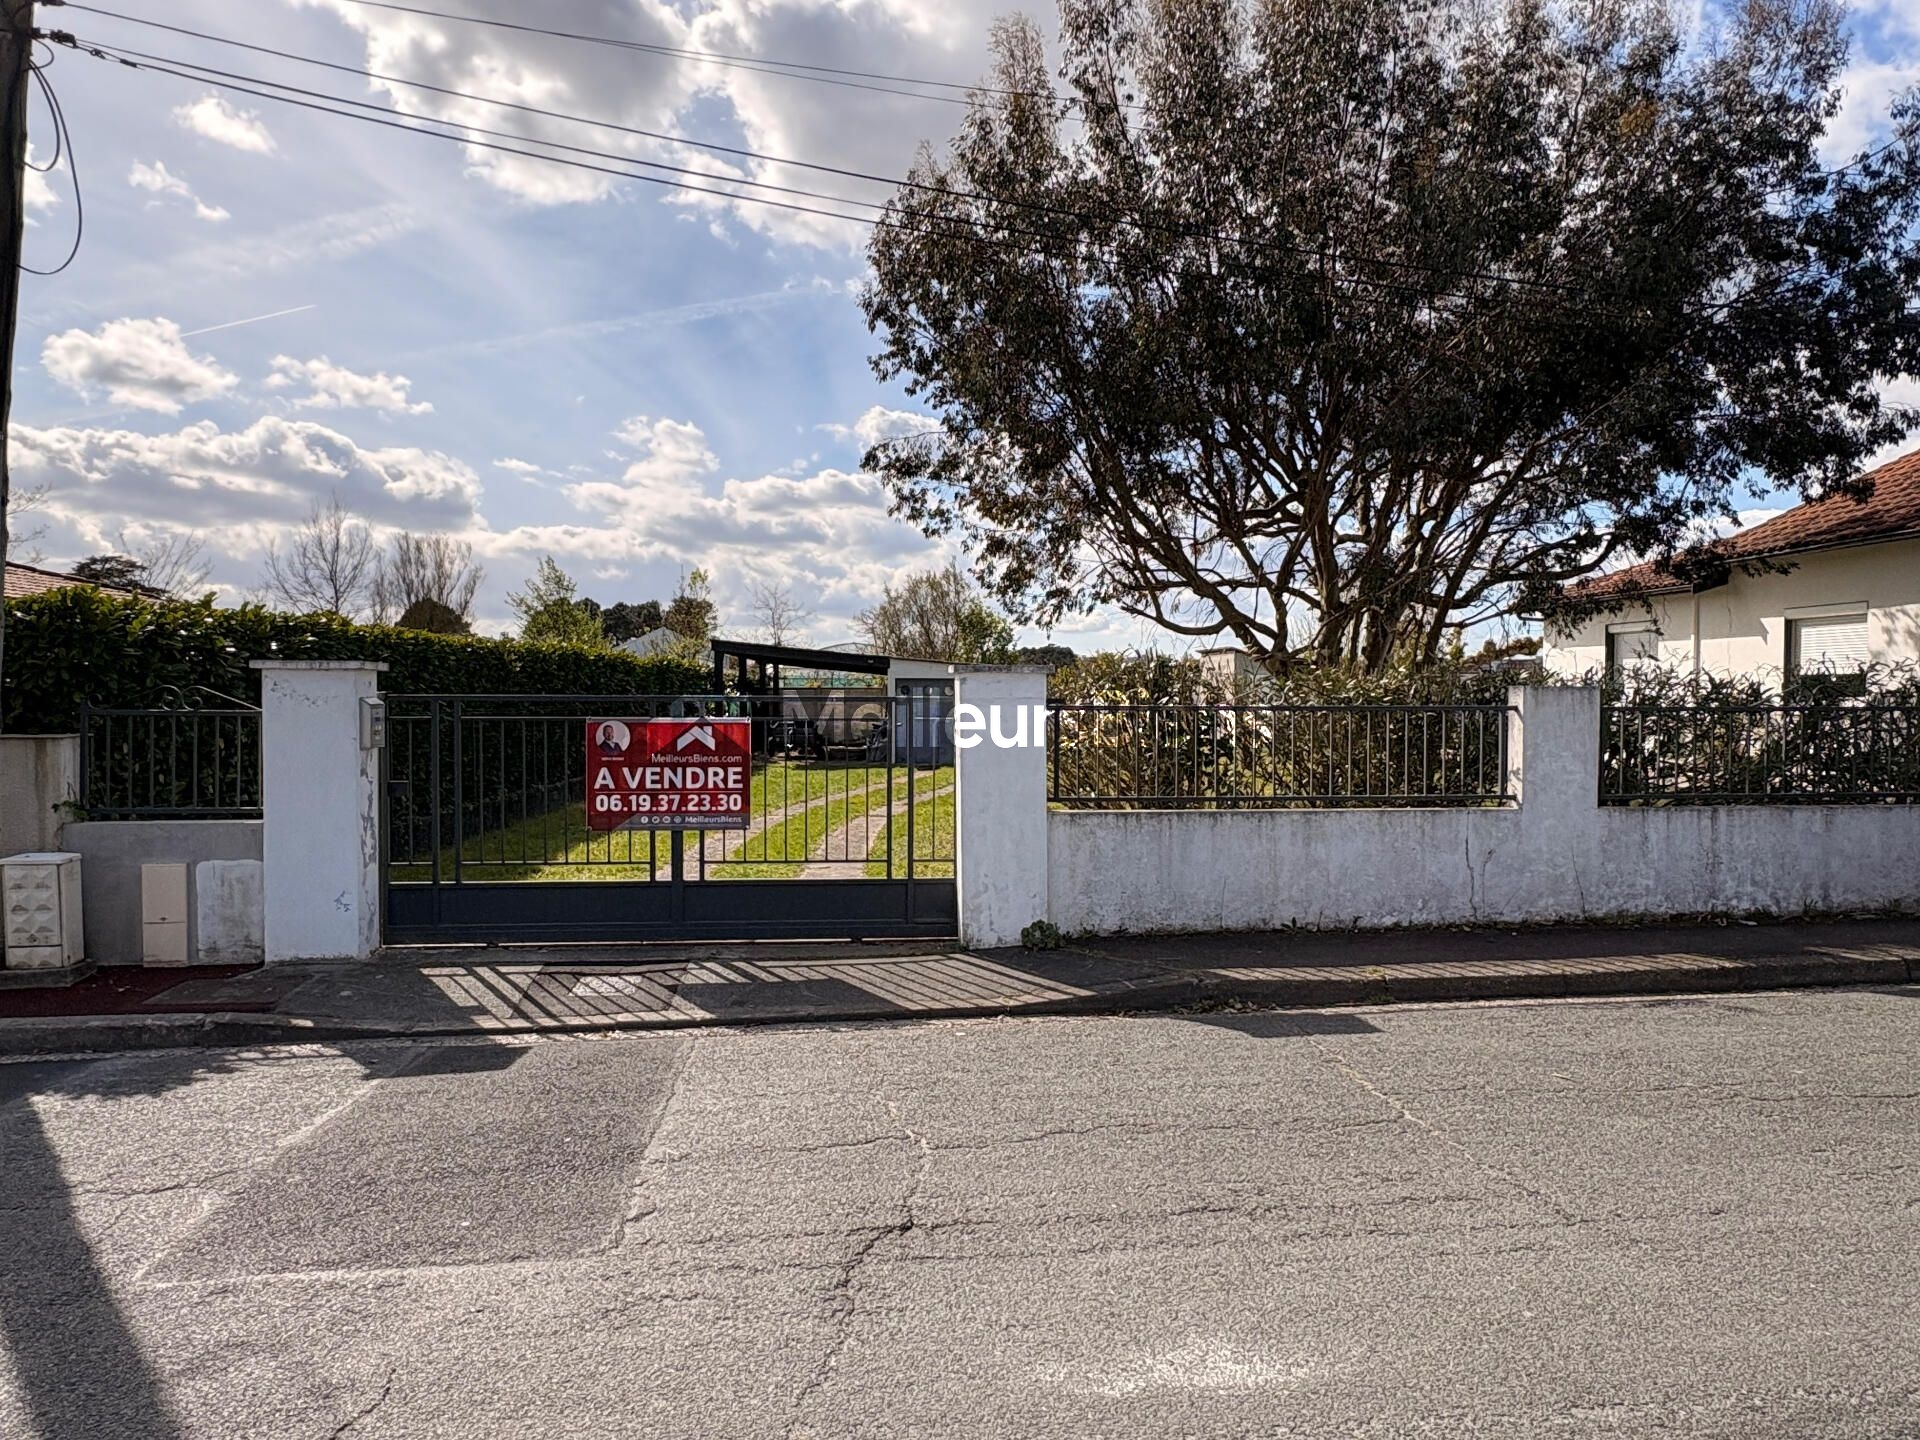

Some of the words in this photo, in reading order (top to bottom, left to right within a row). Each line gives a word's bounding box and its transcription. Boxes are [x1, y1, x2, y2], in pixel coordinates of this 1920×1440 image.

[652, 754, 742, 763] MeilleursBiens.com
[594, 767, 615, 789] A
[622, 767, 743, 789] VENDRE
[595, 794, 741, 811] 06.19.37.23.30
